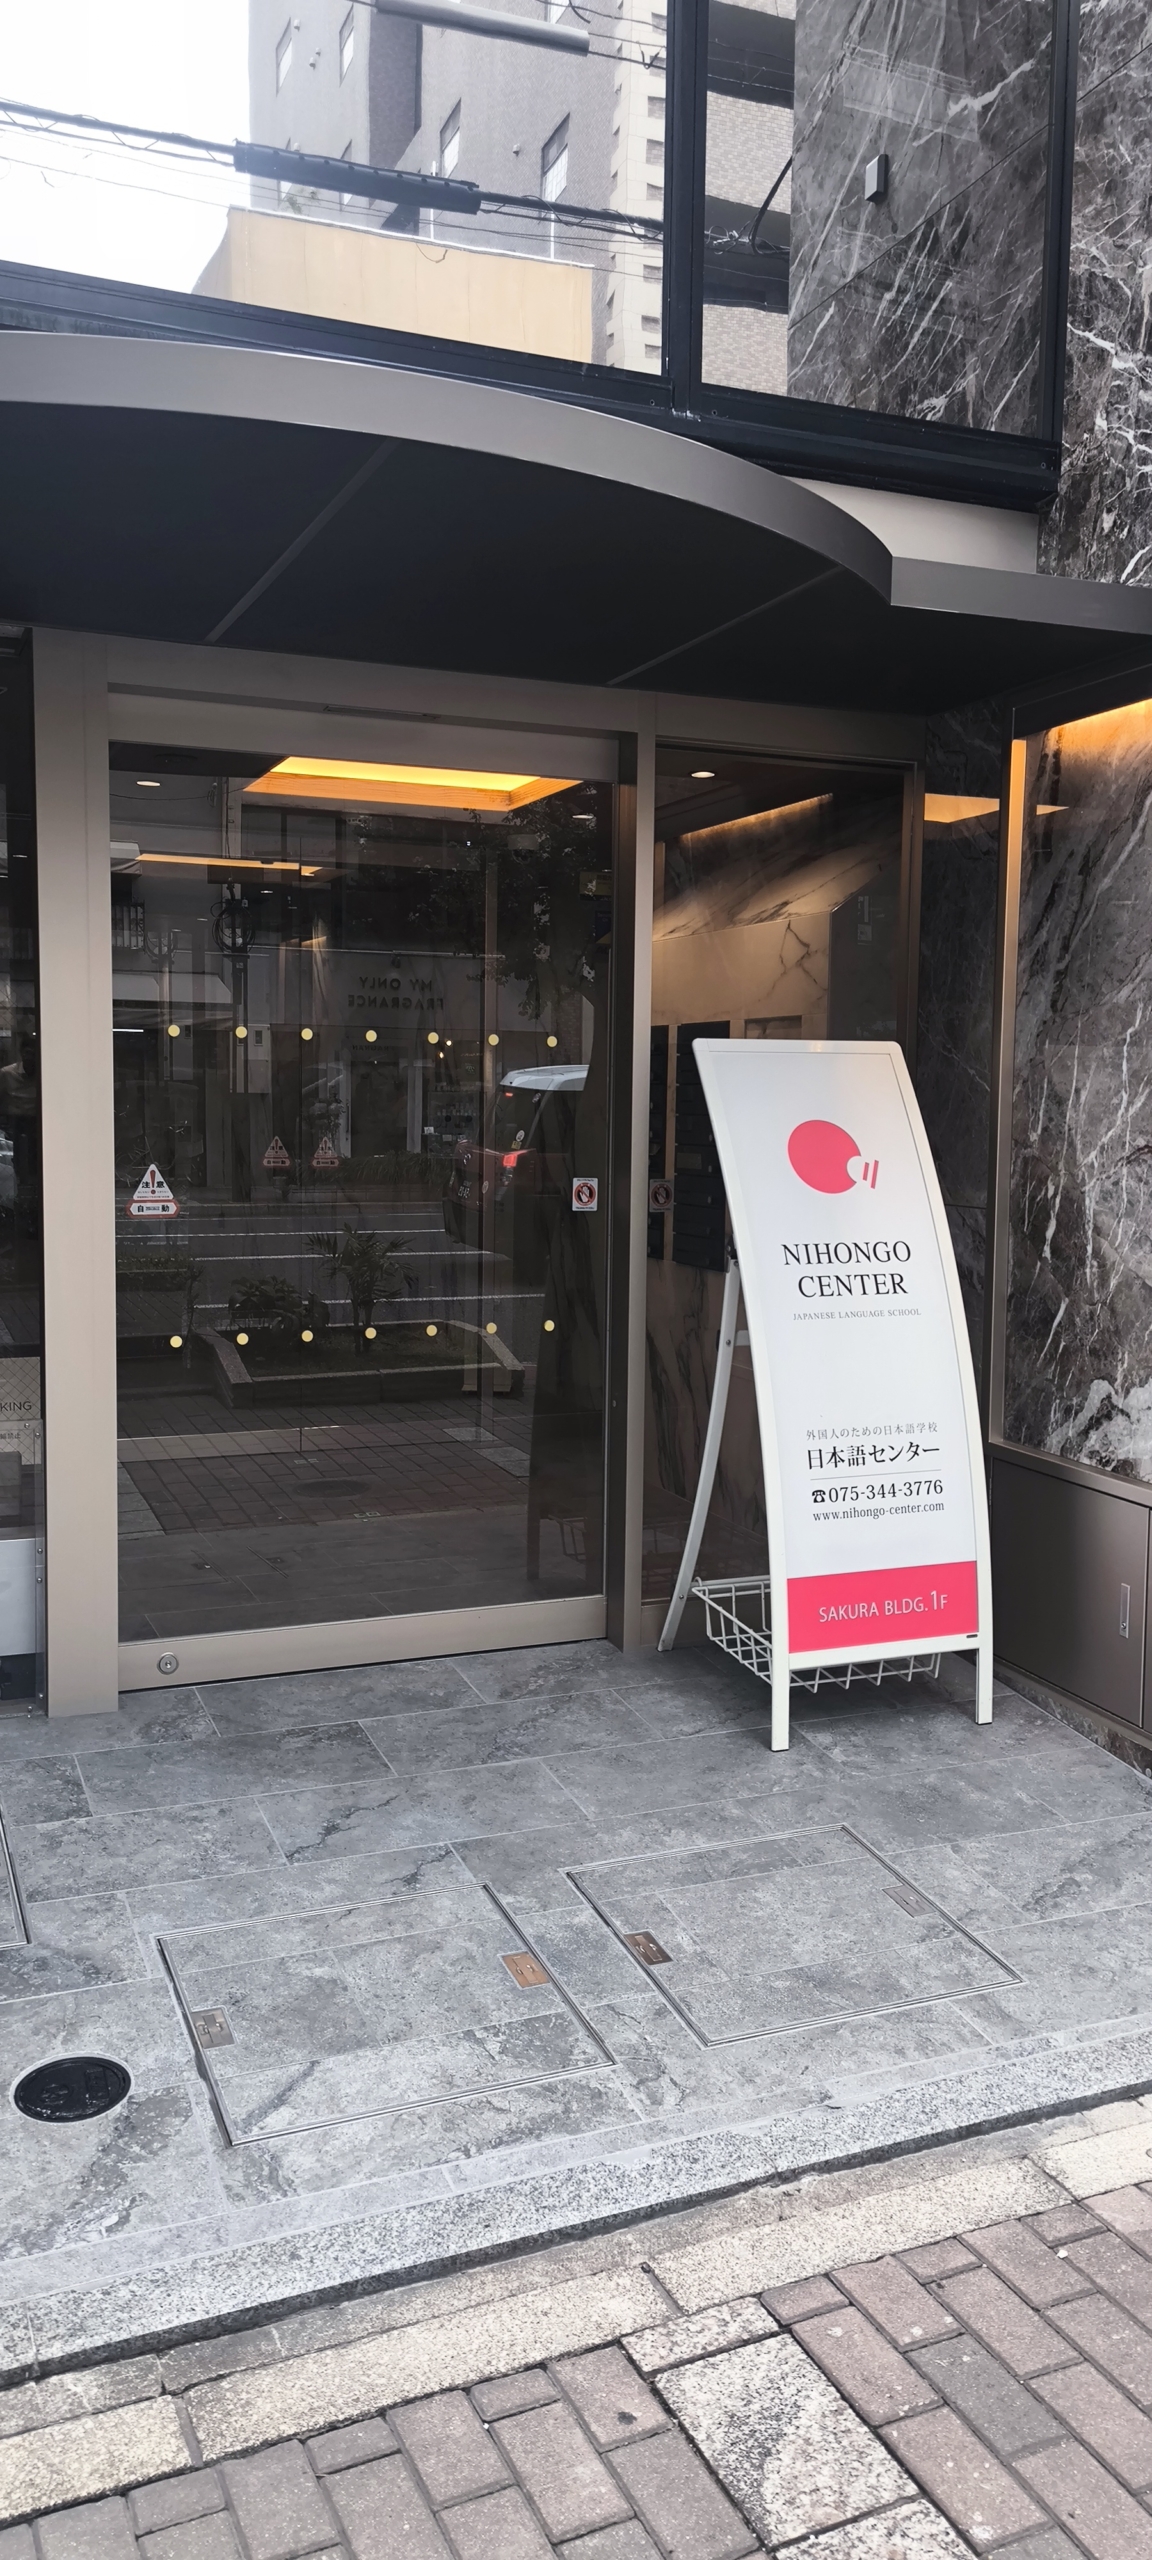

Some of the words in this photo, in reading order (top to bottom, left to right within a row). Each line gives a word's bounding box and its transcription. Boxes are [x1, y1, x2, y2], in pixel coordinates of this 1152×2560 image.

[781, 1240, 911, 1265] NIHONGO
[798, 1273, 908, 1298] CENTER
[793, 1312, 836, 1321] JAPANESE
[838, 1310, 885, 1319] LANGUAGE
[887, 1308, 921, 1317] SCHOOL
[806, 1421, 938, 1441] 外国人のための日本語学校
[807, 1441, 940, 1470] 日本語センター
[828, 1479, 944, 1503] 075-344-3776
[812, 1502, 945, 1521] www.nihongo-center.com
[819, 1602, 879, 1623] SAKURA
[884, 1597, 928, 1616] BLDG.
[930, 1590, 948, 1610] 1F
